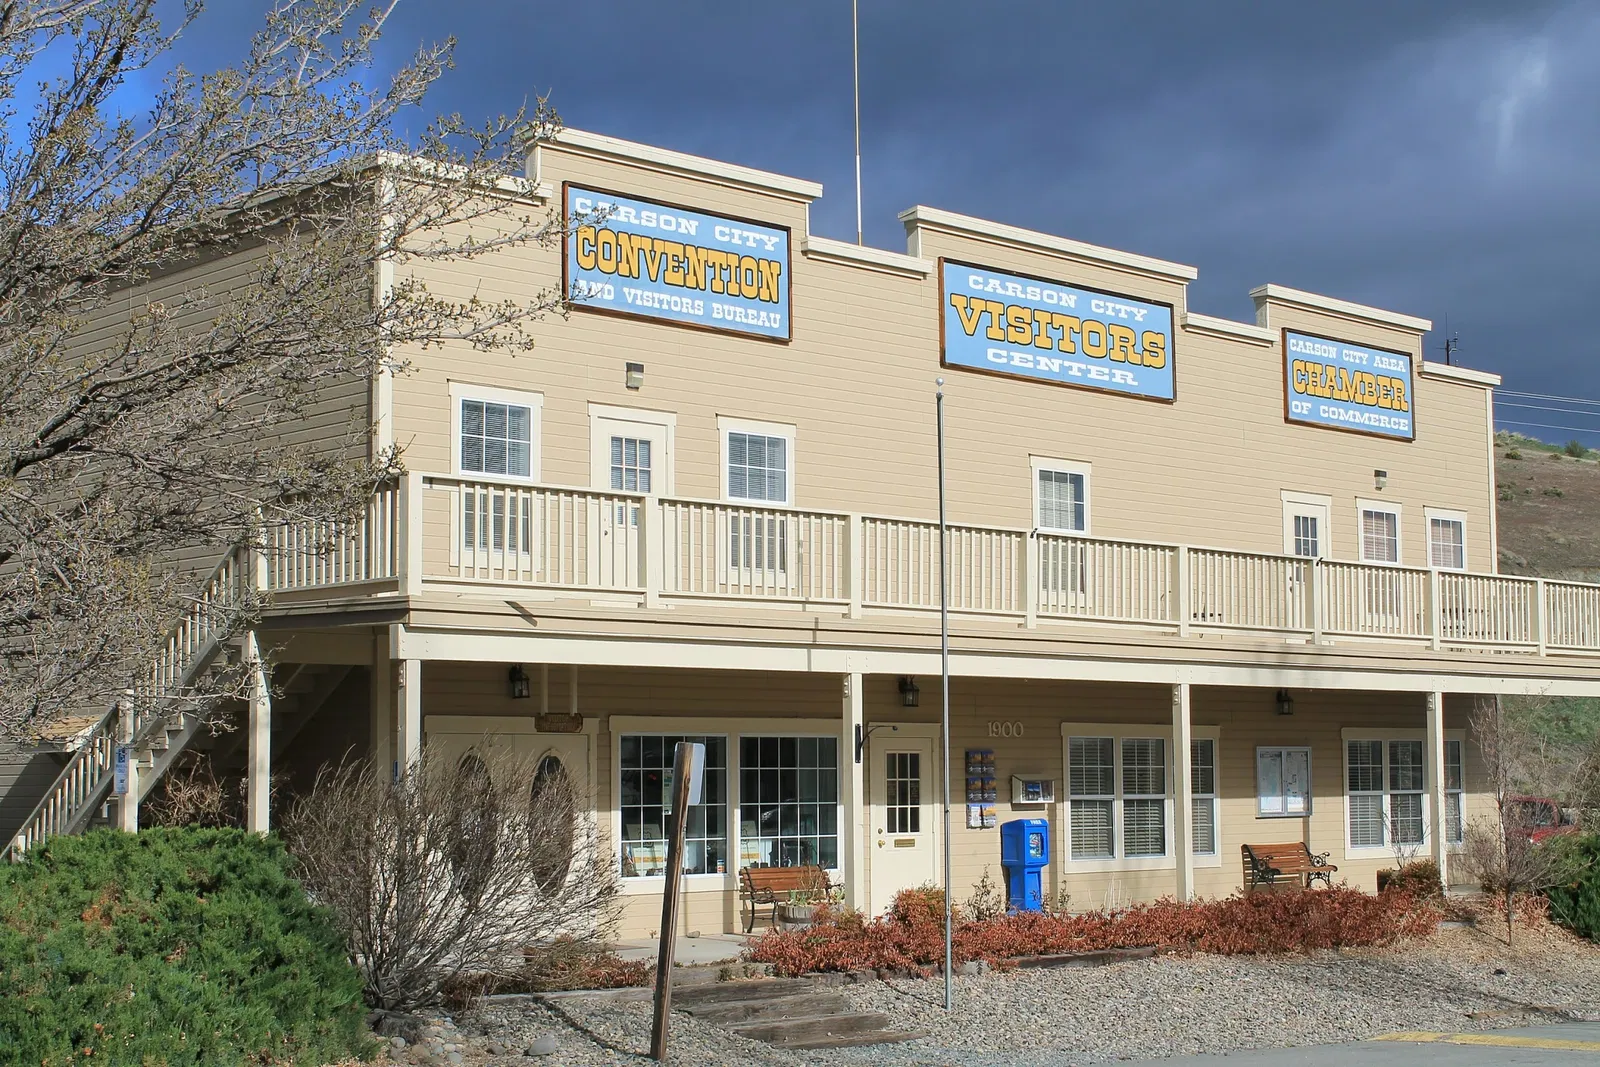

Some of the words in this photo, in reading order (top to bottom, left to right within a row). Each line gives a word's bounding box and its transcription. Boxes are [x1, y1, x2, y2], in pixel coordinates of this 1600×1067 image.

[714, 225, 780, 251] CITY
[576, 226, 782, 304] CONVENTION
[622, 287, 704, 316] VISITORS
[711, 303, 781, 329] BUREAU
[968, 275, 1077, 308] CARSON
[1090, 299, 1148, 322] CITY
[950, 293, 1166, 369] VISITORS
[986, 348, 1139, 386] CENTER
[1289, 339, 1337, 359] CARSON
[1342, 349, 1368, 365] CITY
[1373, 355, 1406, 373] AREA
[1292, 358, 1409, 412] CHAMBER
[1291, 400, 1312, 415] OF
[1320, 405, 1409, 431] COMMERCE
[987, 721, 1024, 738] 1900
